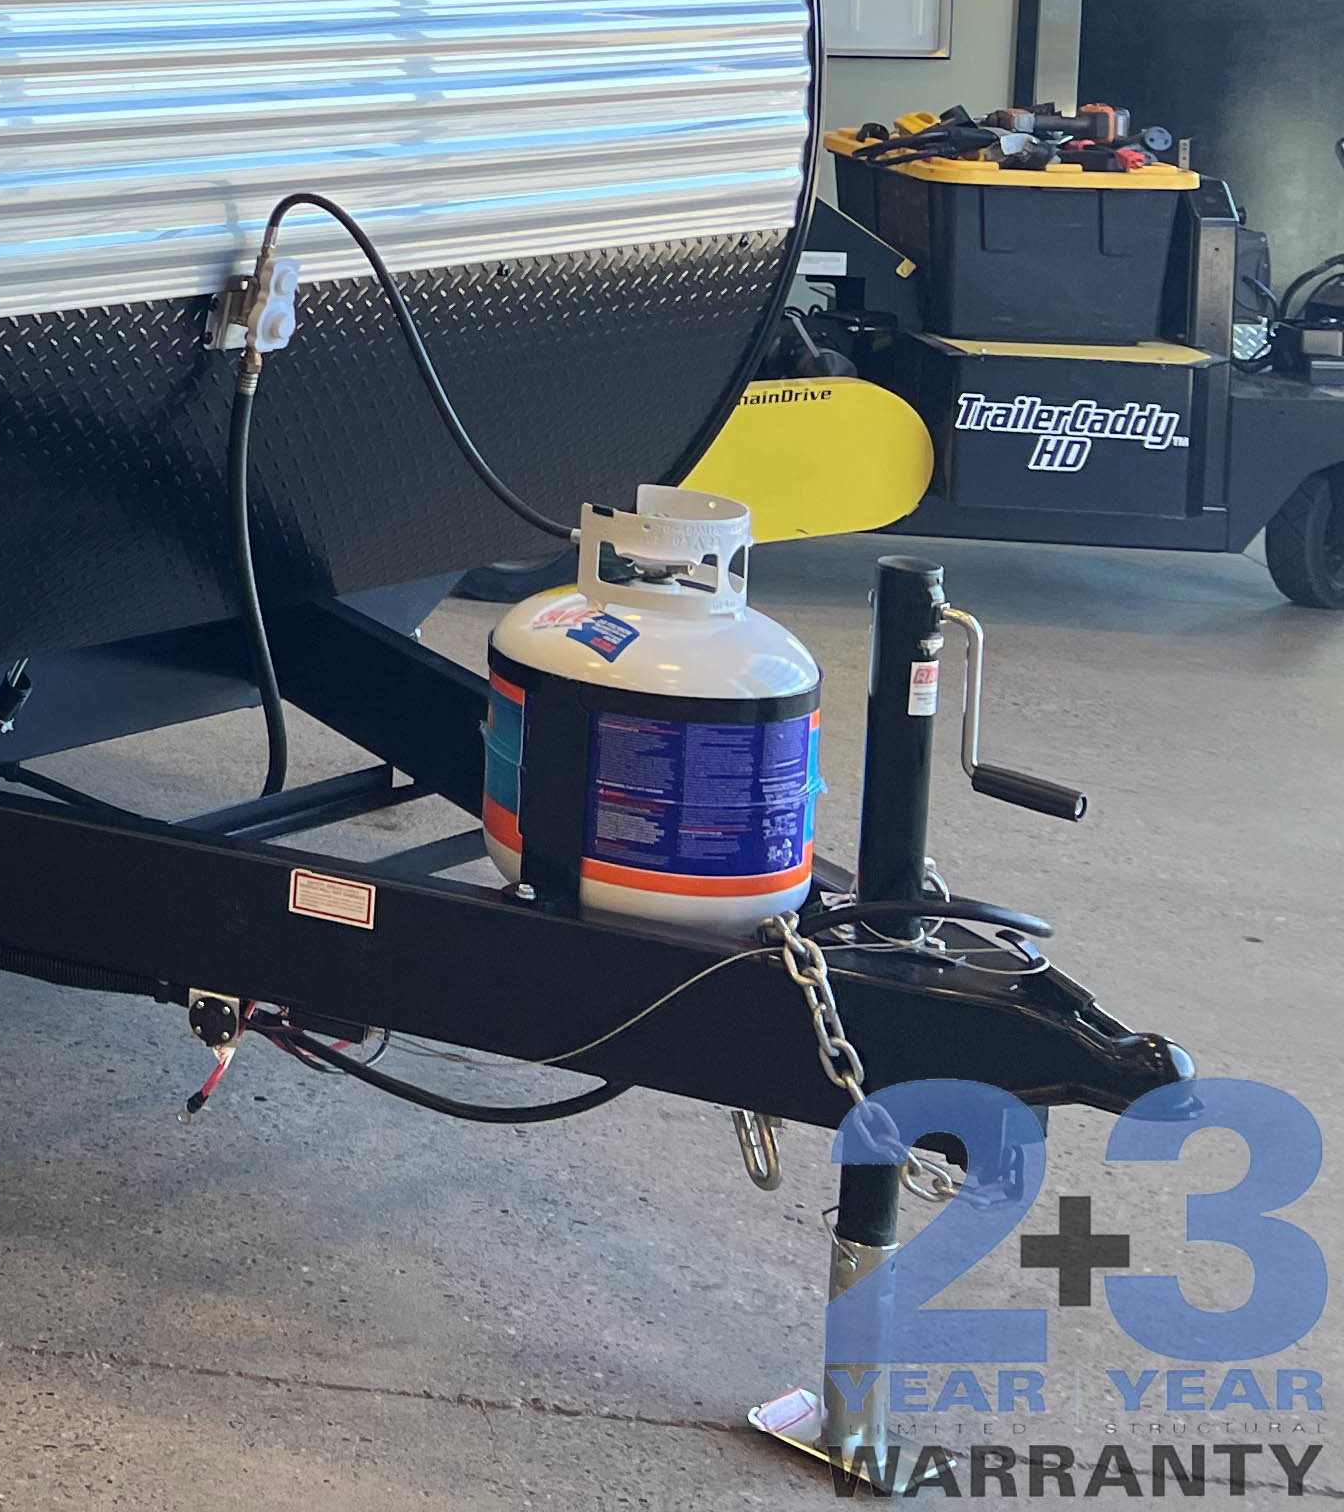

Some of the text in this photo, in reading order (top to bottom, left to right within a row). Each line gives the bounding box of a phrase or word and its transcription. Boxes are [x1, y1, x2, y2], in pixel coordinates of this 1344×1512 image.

[736, 389, 832, 406] hainDrive
[955, 393, 1179, 449] TrailerCaddy
[1028, 435, 1091, 471] HD
